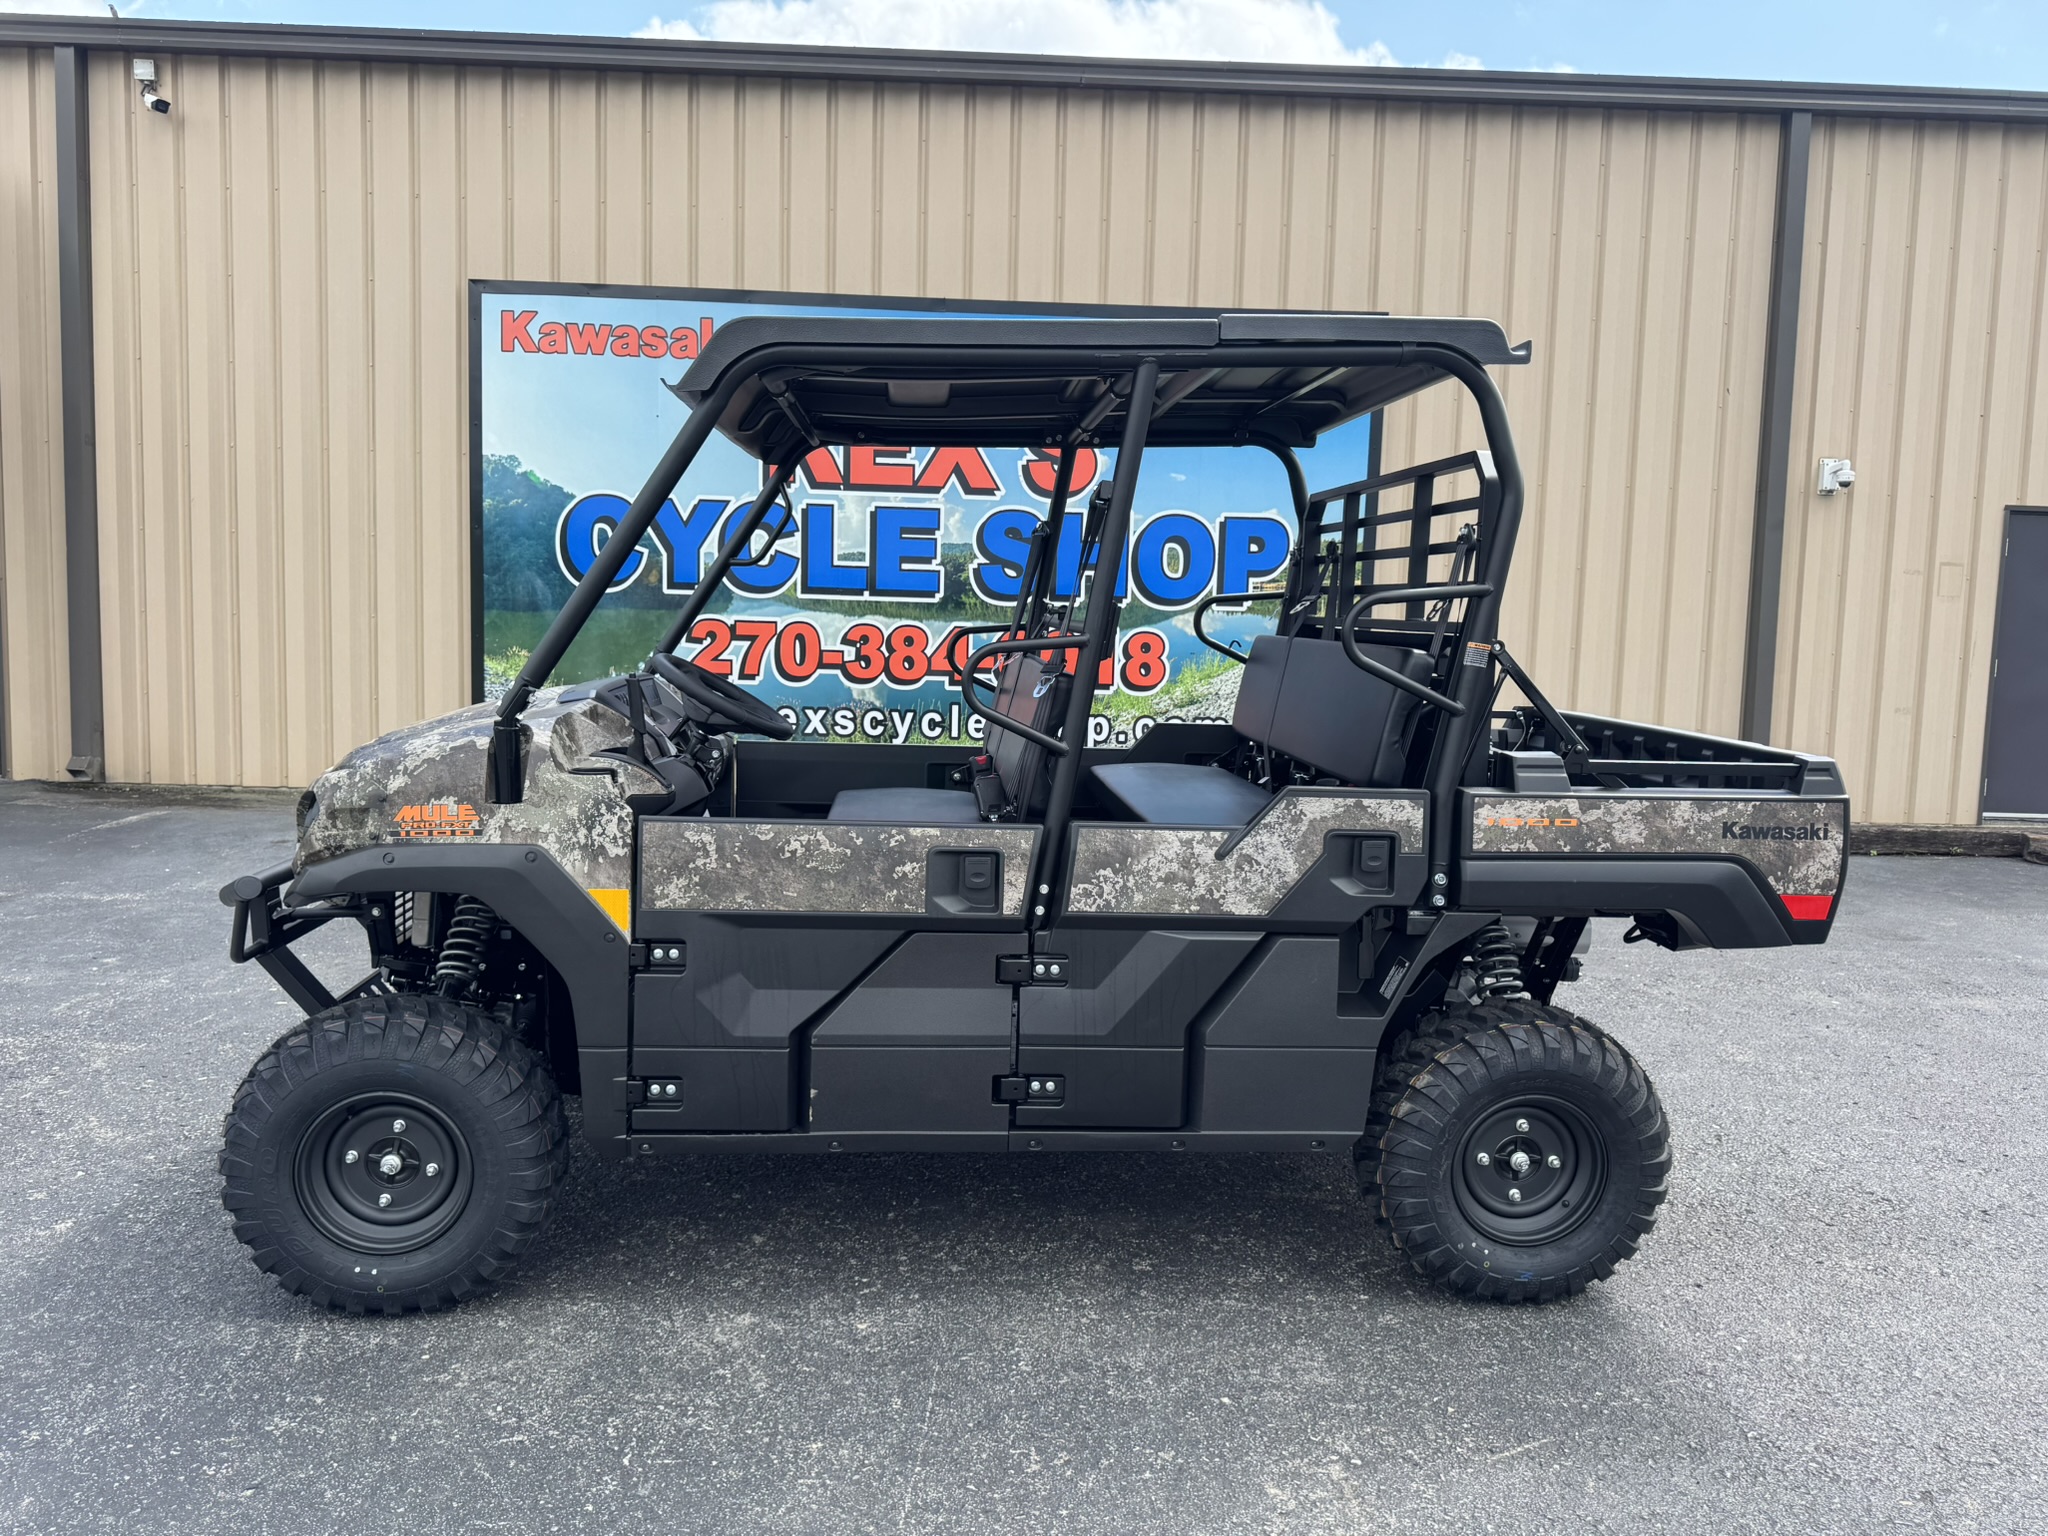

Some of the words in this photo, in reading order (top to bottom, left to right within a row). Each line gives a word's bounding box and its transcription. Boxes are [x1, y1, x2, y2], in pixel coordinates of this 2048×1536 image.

[562, 494, 943, 600] CYCLE
[971, 508, 1288, 608] SHOP
[685, 616, 1167, 692] 270-384-8
[393, 804, 480, 822] MULE
[400, 829, 474, 837] 1000
[1721, 821, 1829, 841] Kawasaki
